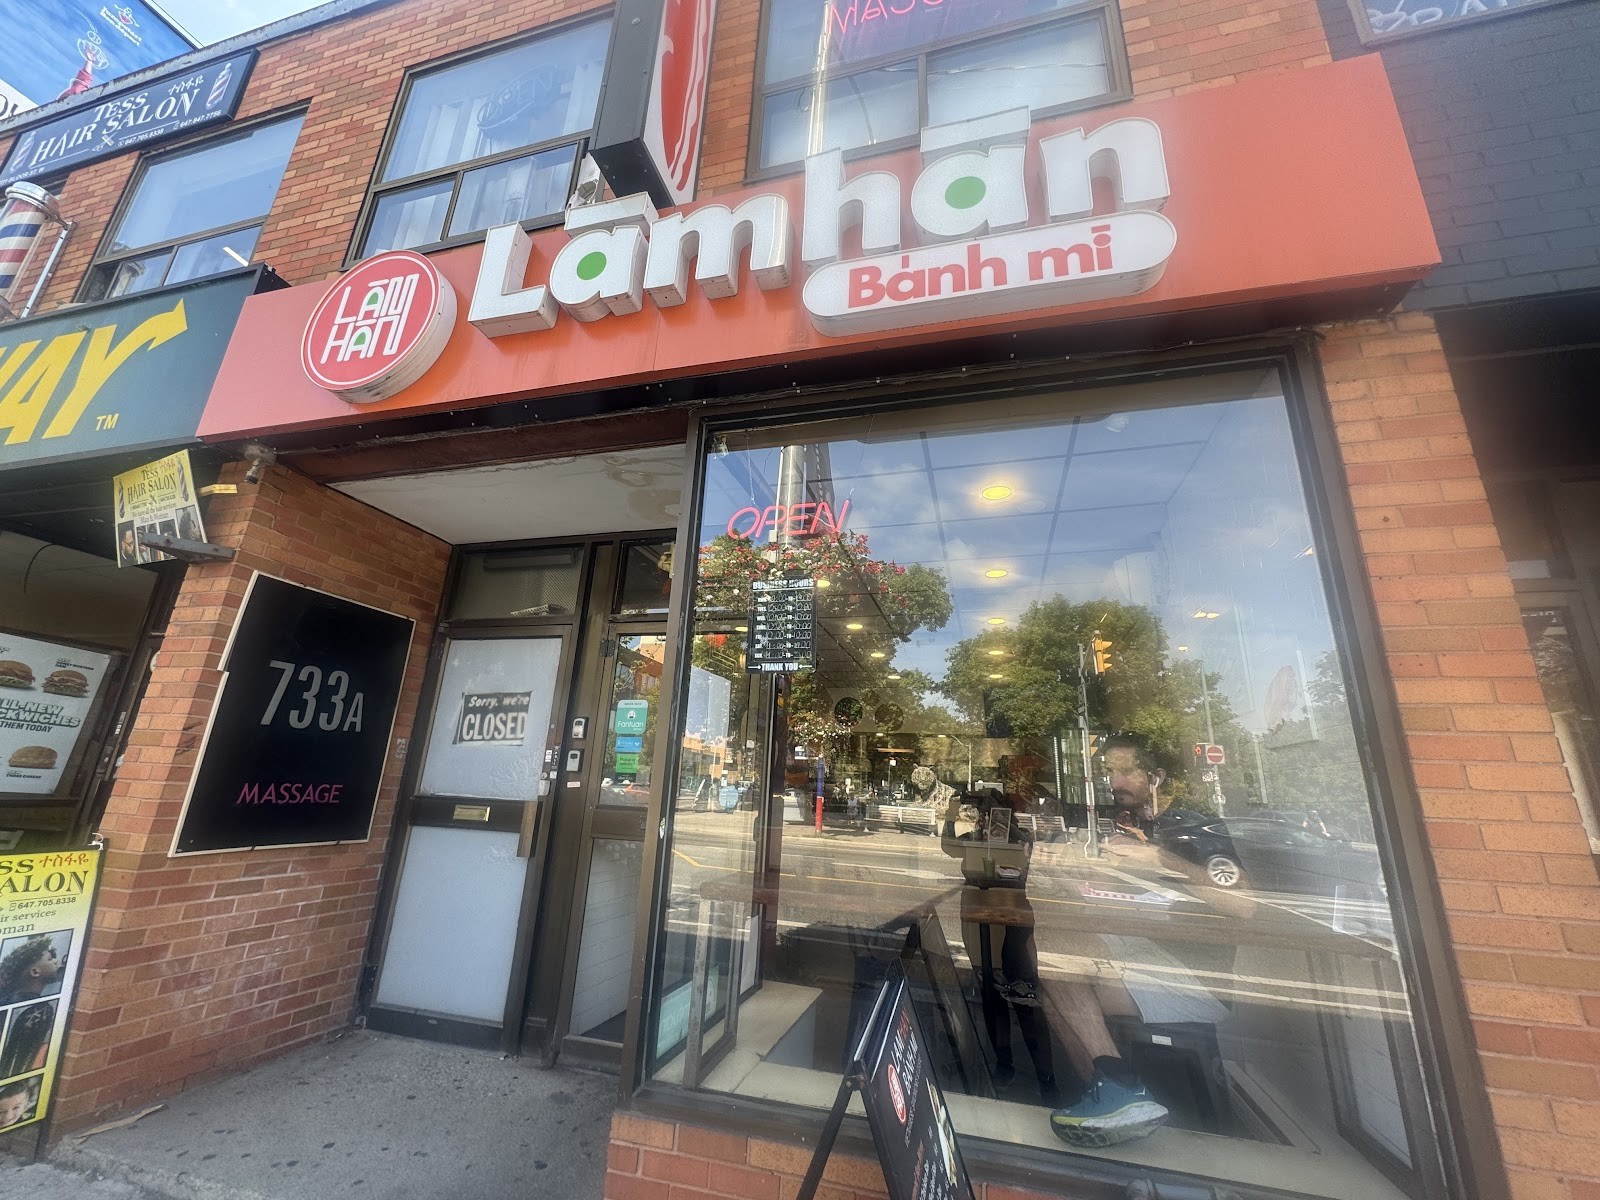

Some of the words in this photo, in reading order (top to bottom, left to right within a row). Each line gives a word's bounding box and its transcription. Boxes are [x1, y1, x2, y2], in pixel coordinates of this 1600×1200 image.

[94, 92, 148, 122] TESS
[28, 123, 98, 167] HAIR
[102, 88, 200, 134] SALON
[96, 413, 120, 431] TM
[141, 467, 159, 481] TESS
[127, 482, 147, 504] HAIR
[148, 473, 177, 493] SALON
[727, 499, 850, 540] OPEN
[761, 662, 783, 672] THANK
[785, 662, 799, 671] YOU
[0, 698, 64, 716] LL-NEW
[0, 722, 24, 731] THEM
[25, 722, 53, 733] TODAY
[462, 711, 529, 742] CLOSED
[617, 720, 644, 729] Fantuan
[236, 782, 344, 805] MASSAGE
[18, 896, 77, 909] 647.705.8338
[12, 909, 57, 921] services
